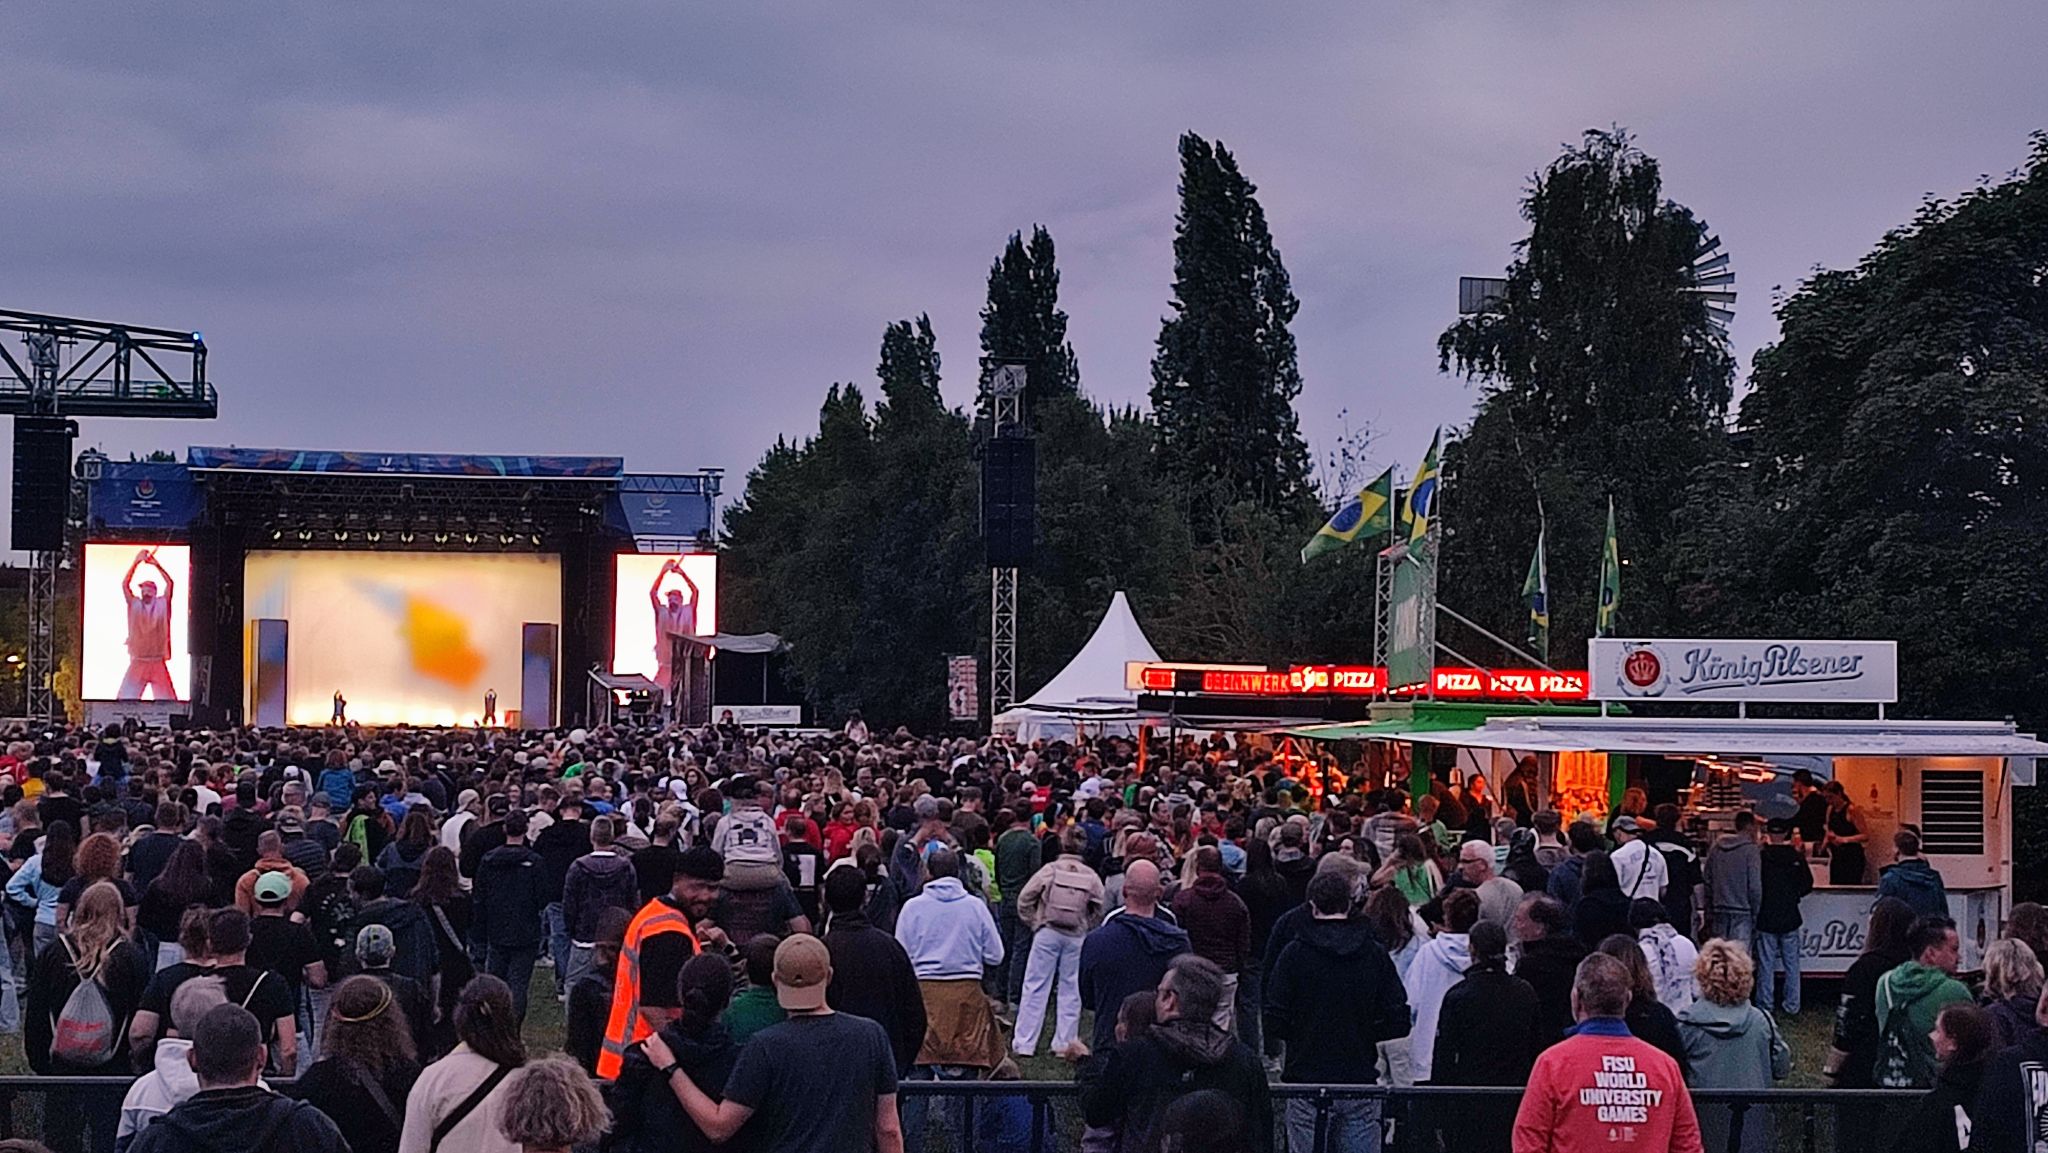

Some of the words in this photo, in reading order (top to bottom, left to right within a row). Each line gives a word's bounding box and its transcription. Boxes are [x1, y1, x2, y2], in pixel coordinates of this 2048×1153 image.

[1437, 674, 1481, 690] PIZZA
[1602, 1056, 1636, 1072] FISU
[1593, 1071, 1648, 1089] WORLD
[1580, 1088, 1663, 1107] UNIVERSITY
[1597, 1105, 1648, 1123] GAMES
